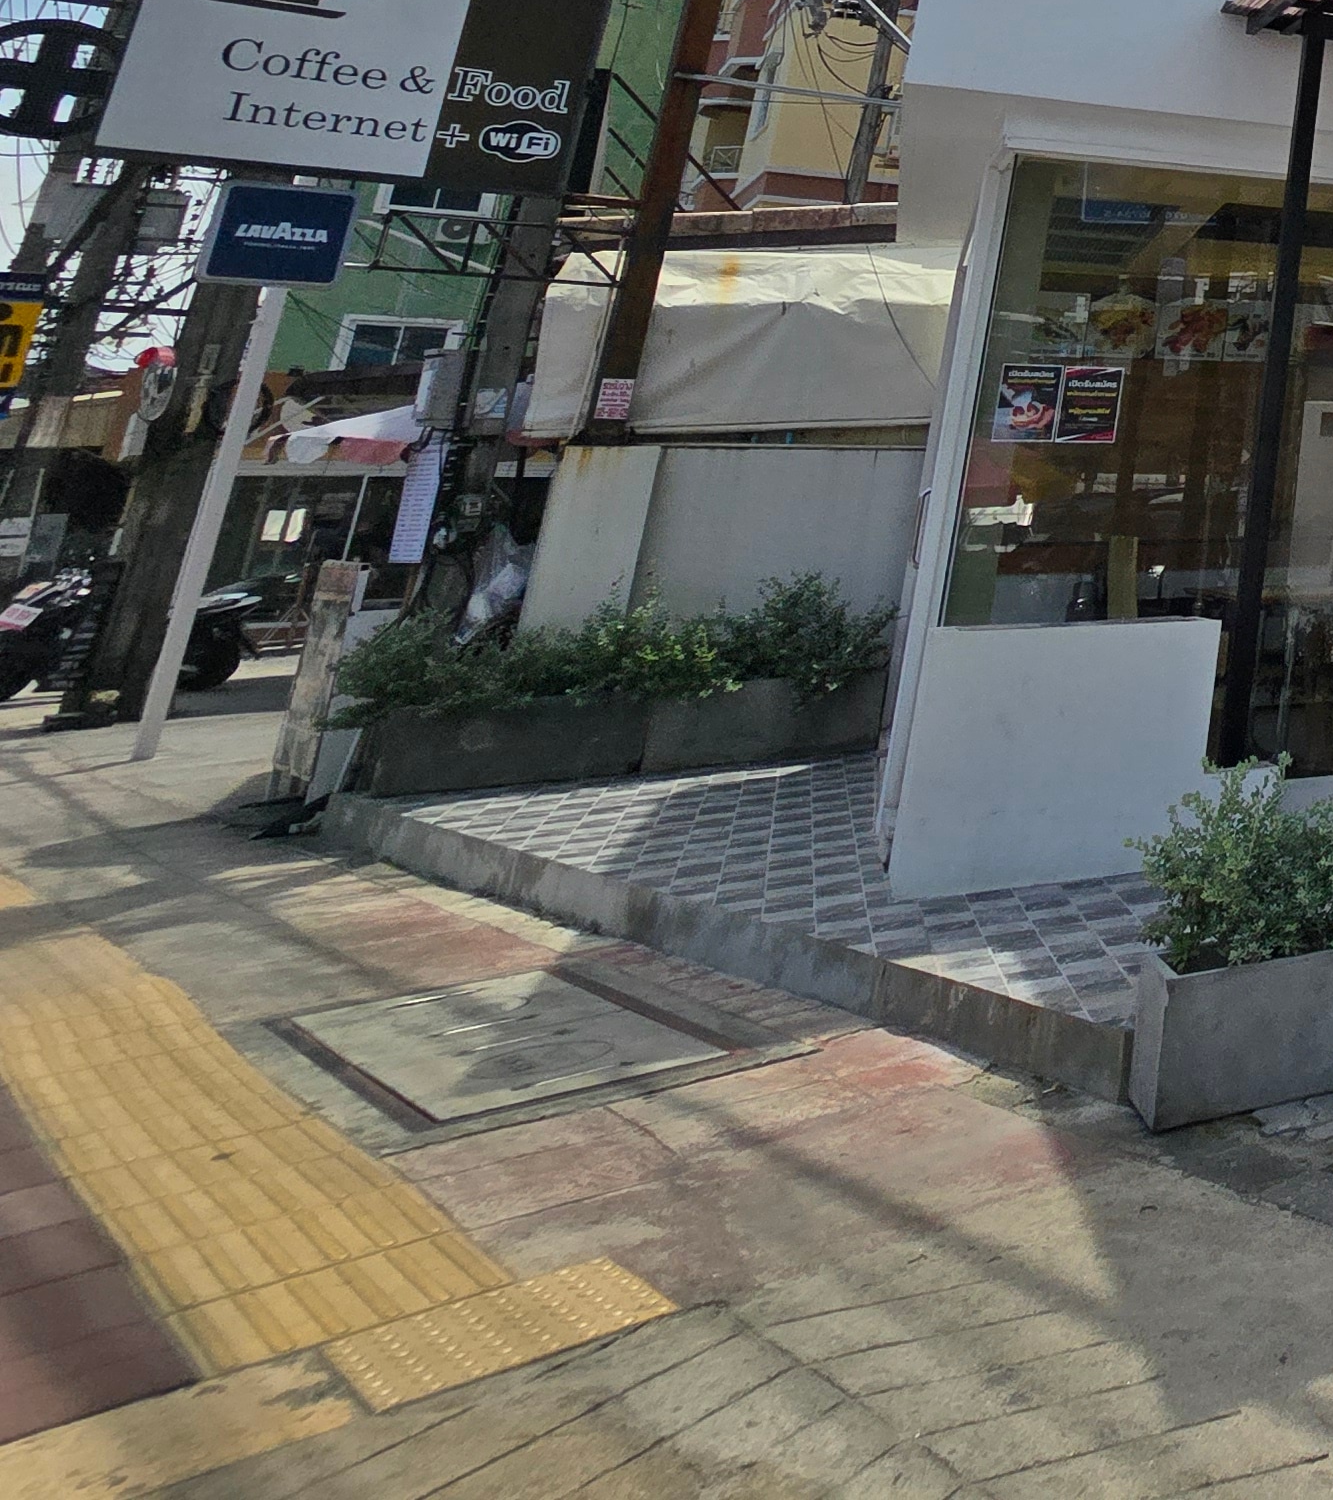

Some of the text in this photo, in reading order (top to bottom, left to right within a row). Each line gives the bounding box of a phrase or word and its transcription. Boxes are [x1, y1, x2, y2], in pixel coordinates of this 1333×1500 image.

[221, 38, 571, 114] Coffee & Food
[222, 90, 428, 143] Internet
[234, 222, 328, 243] LAVAZZA
